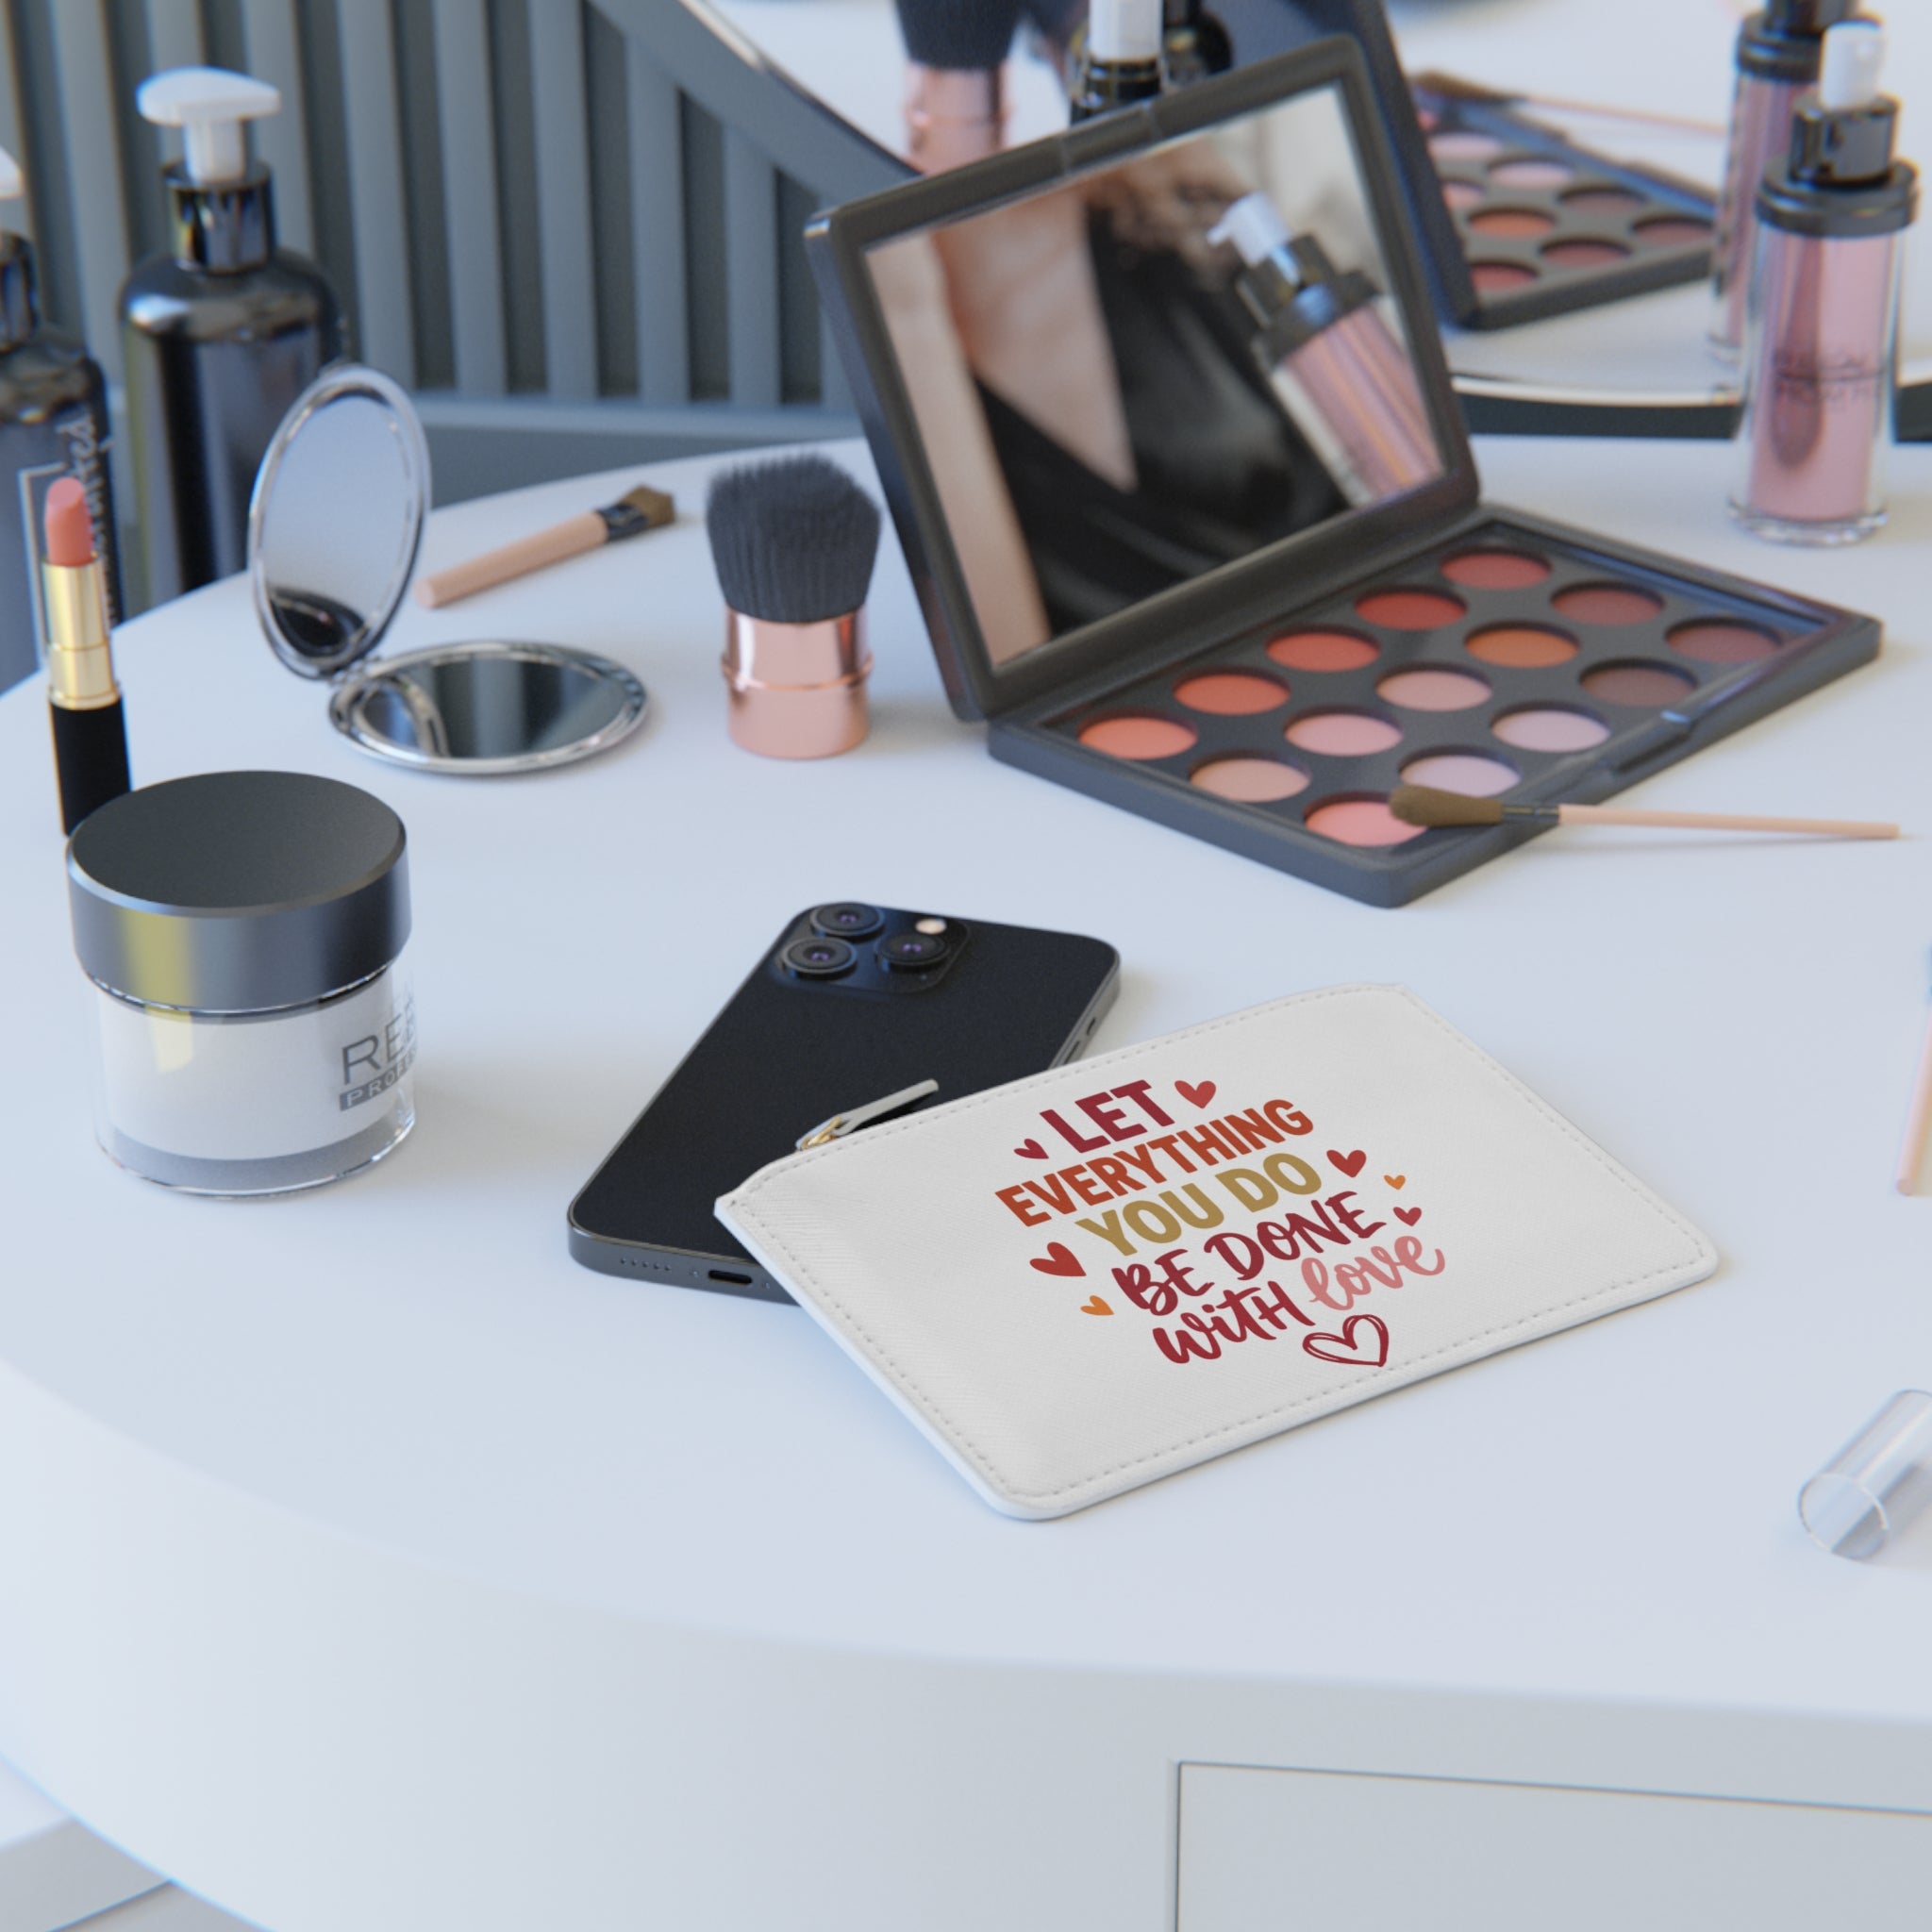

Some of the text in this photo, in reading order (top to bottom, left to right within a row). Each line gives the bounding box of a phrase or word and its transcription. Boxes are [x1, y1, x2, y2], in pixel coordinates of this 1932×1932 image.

[994, 1098, 1314, 1227] EVERYTHING
[1040, 1079, 1175, 1154] LET
[1074, 1153, 1323, 1257] YOU DO
[1111, 1191, 1387, 1316] BE DONE
[1300, 1235, 1446, 1310] love
